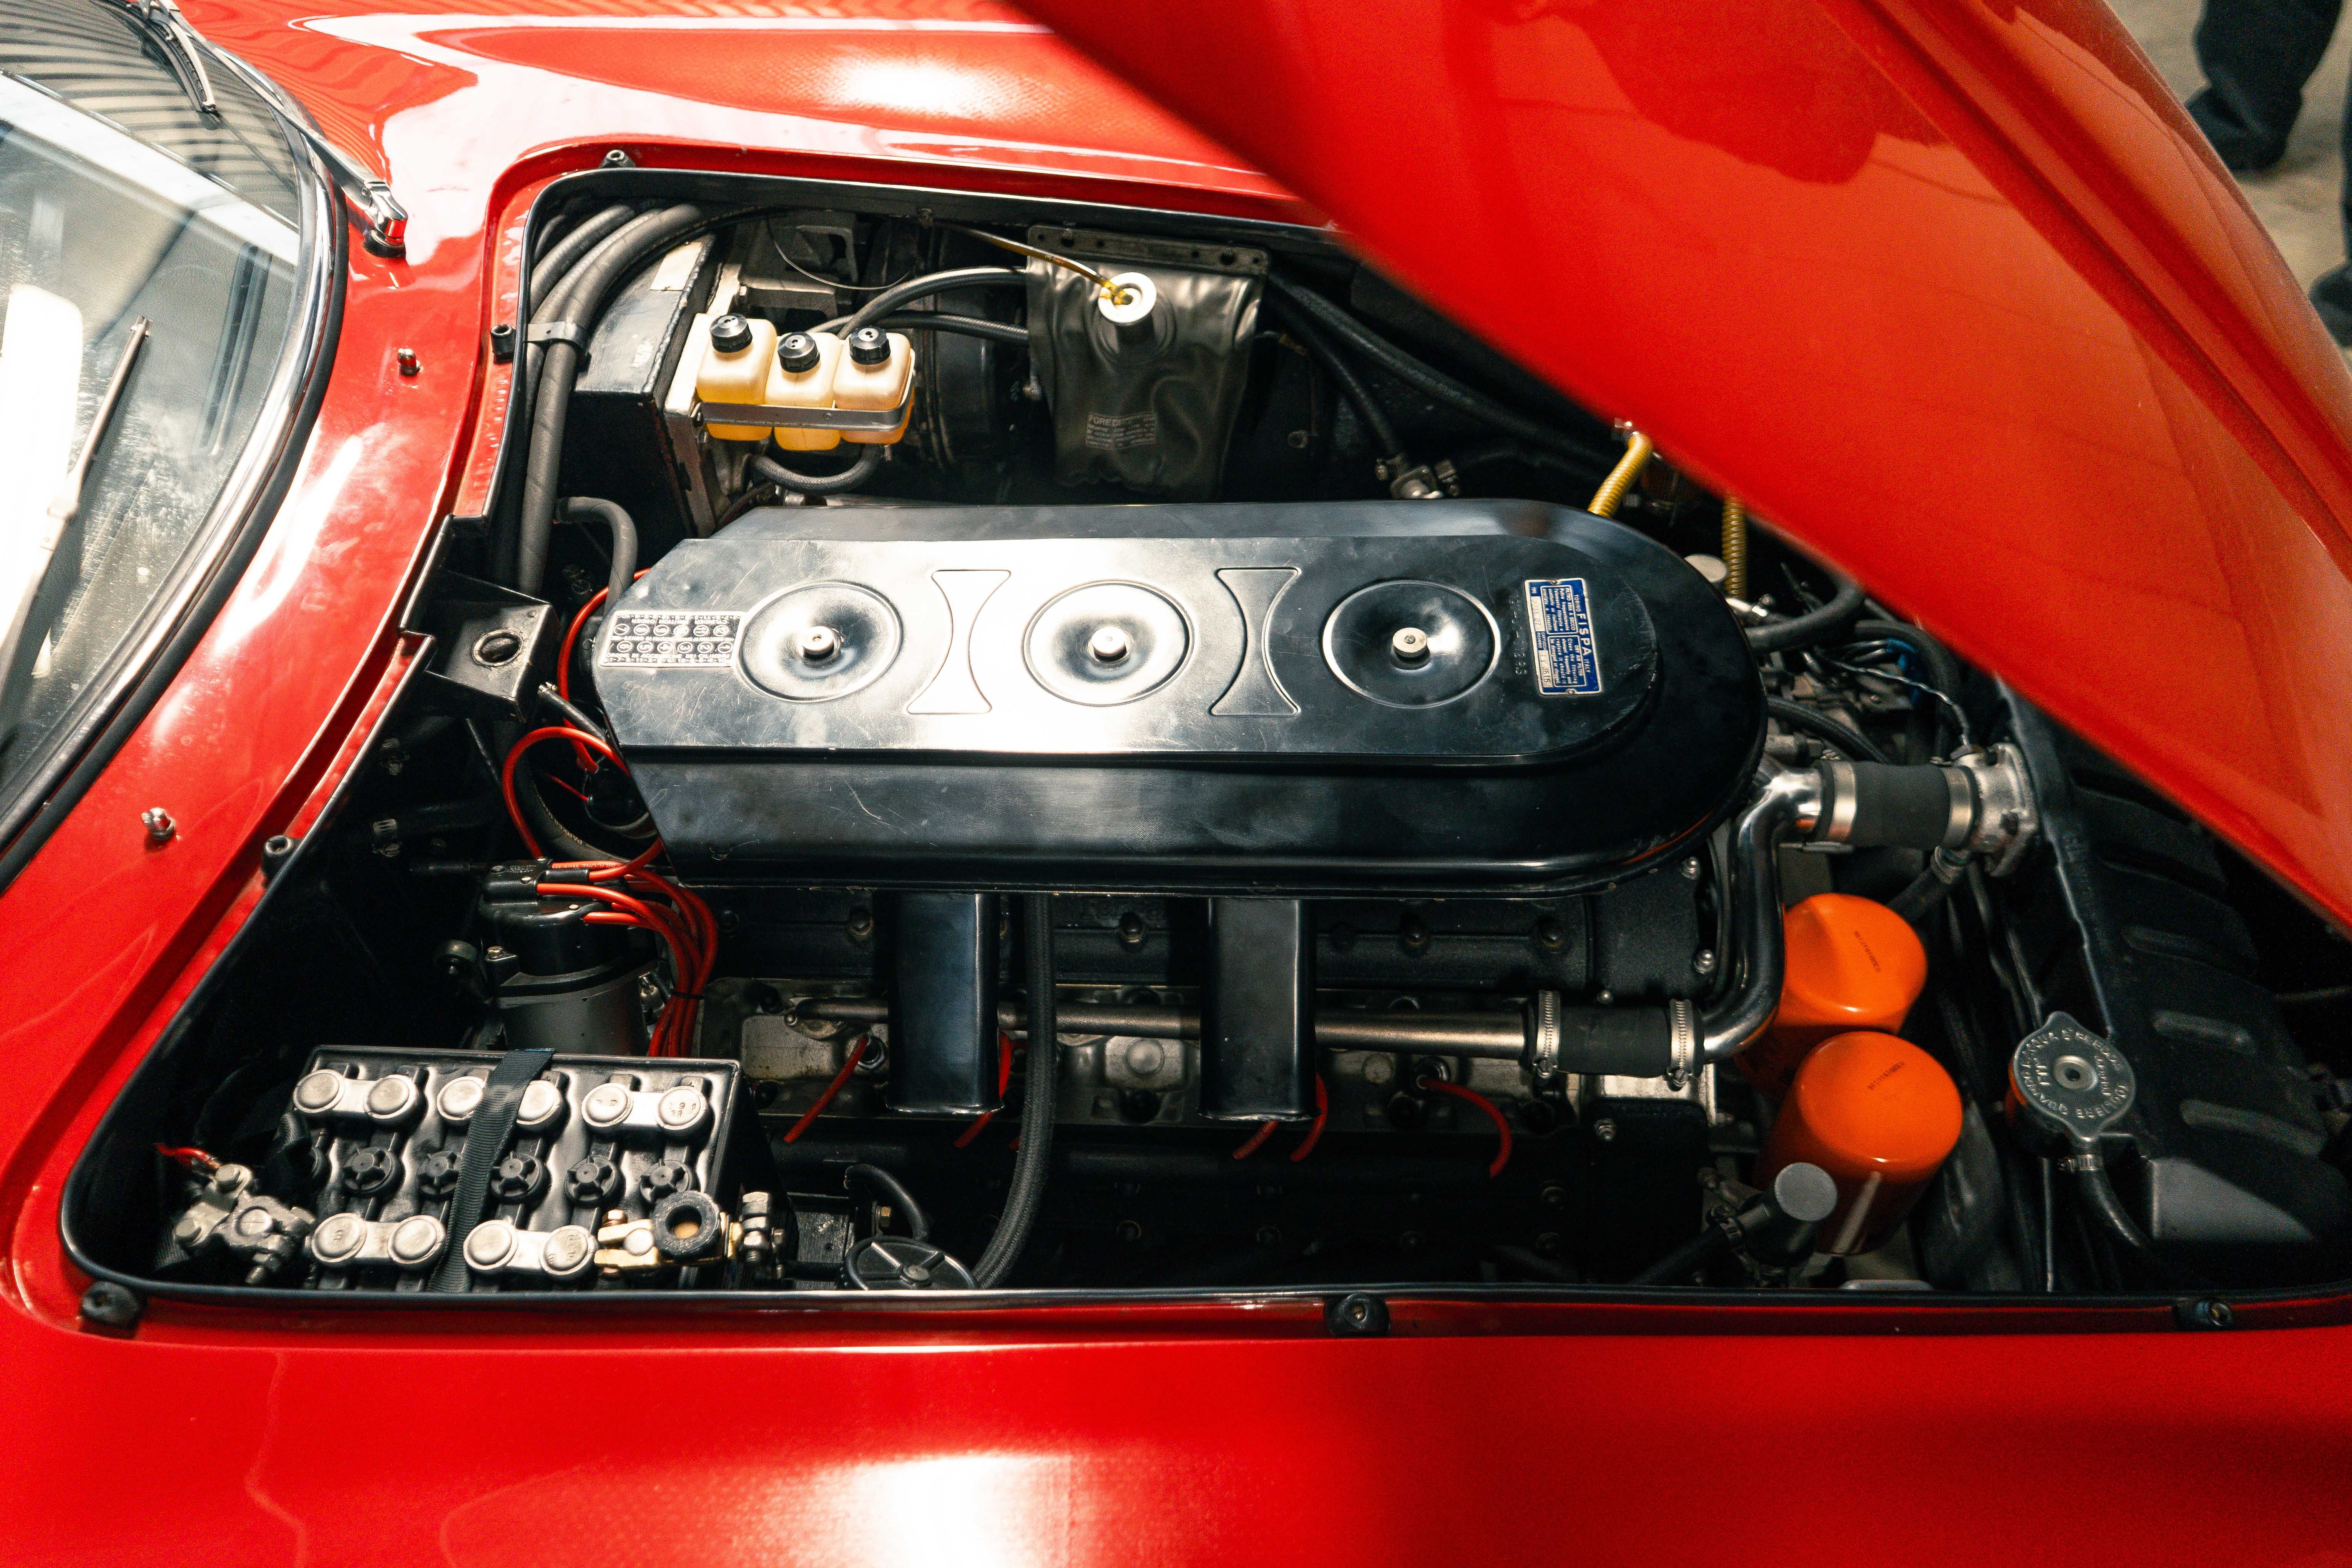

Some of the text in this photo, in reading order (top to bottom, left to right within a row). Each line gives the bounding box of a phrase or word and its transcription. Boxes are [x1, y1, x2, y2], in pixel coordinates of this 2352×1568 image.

[1576, 613, 1592, 655] FISPA
[1563, 656, 1571, 674] frequently
[1570, 664, 1578, 683] filtering
